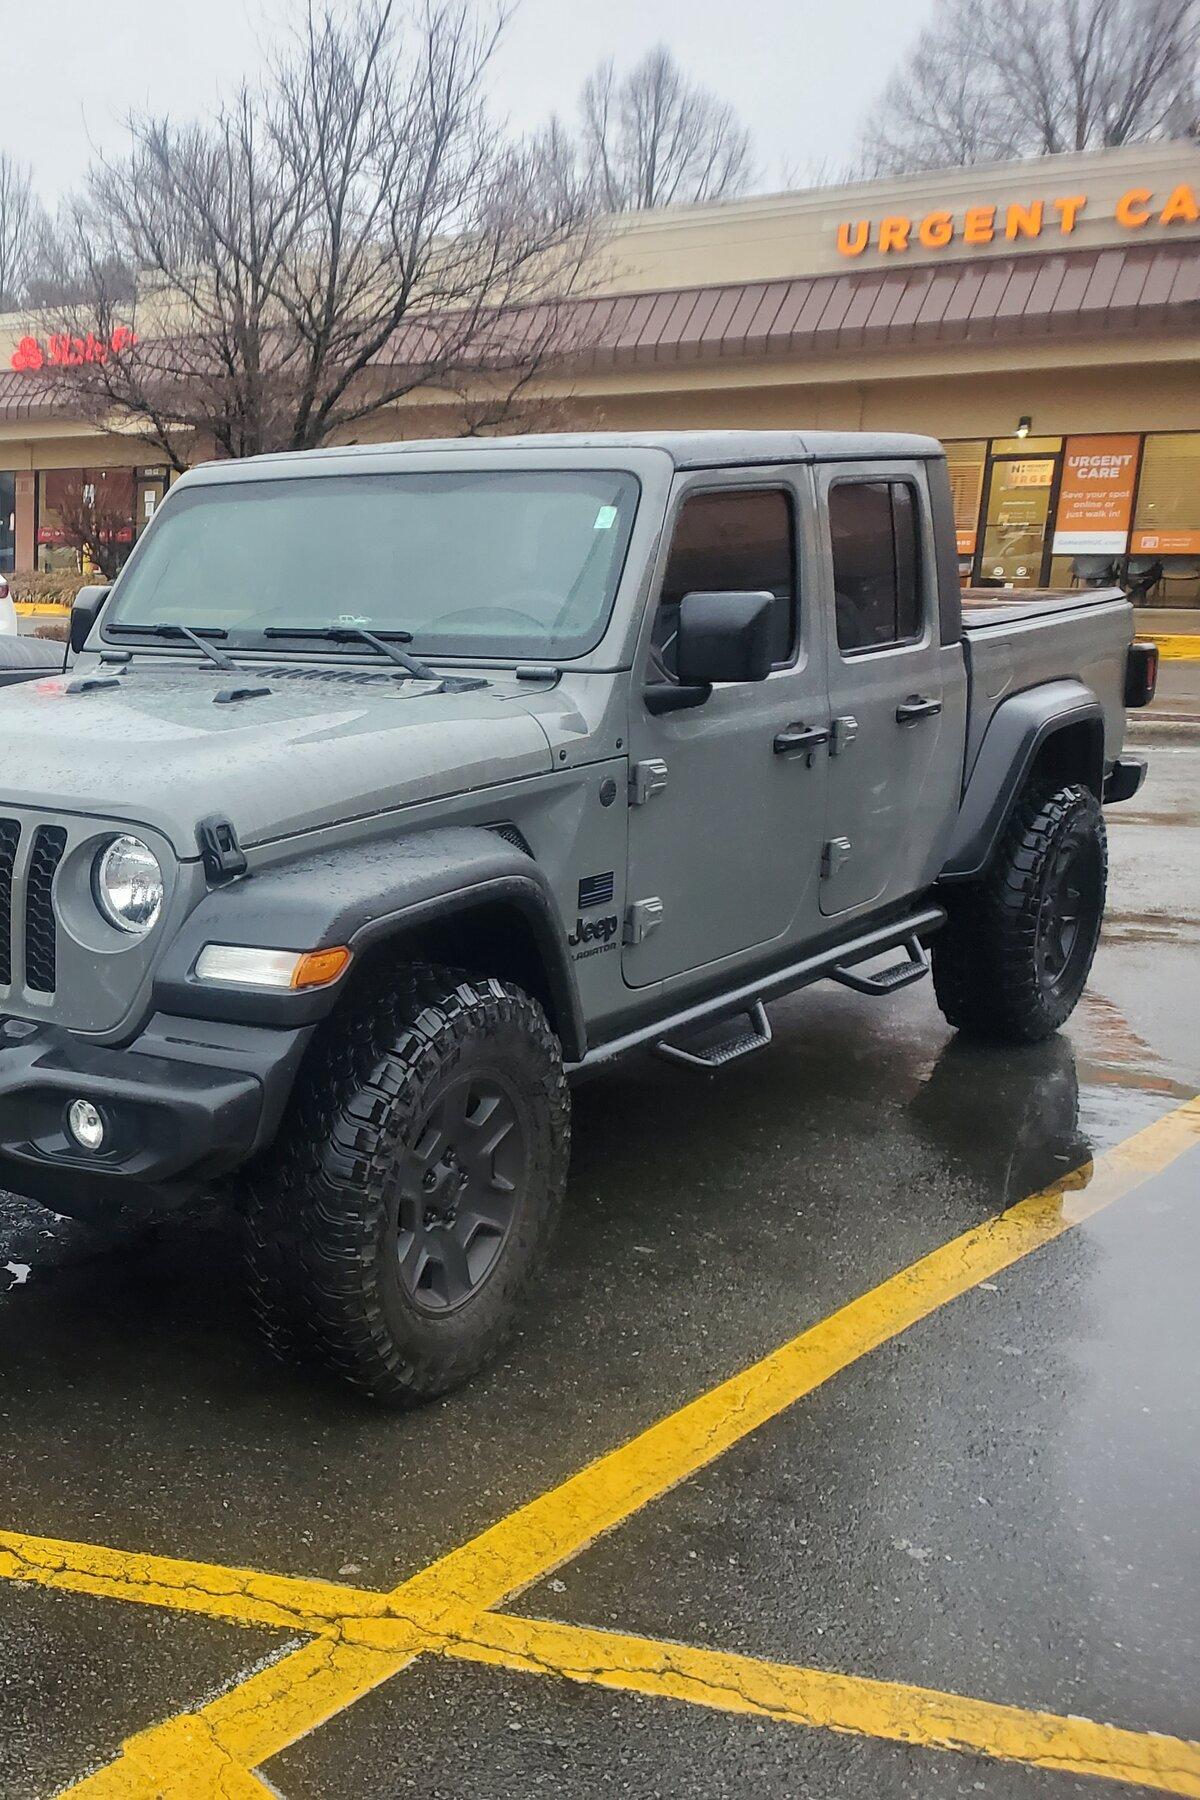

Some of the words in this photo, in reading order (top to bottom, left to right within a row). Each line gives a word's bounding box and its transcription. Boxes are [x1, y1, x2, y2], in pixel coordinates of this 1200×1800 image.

[836, 196, 1086, 257] URGENT
[1068, 455, 1132, 467] URGENT
[1077, 468, 1120, 478] CARE
[1062, 491, 1083, 499] Save
[1087, 492, 1106, 500] your
[1109, 490, 1130, 499] spot
[1066, 511, 1083, 519] just
[1086, 510, 1106, 518] walk
[568, 914, 618, 947] Jeep
